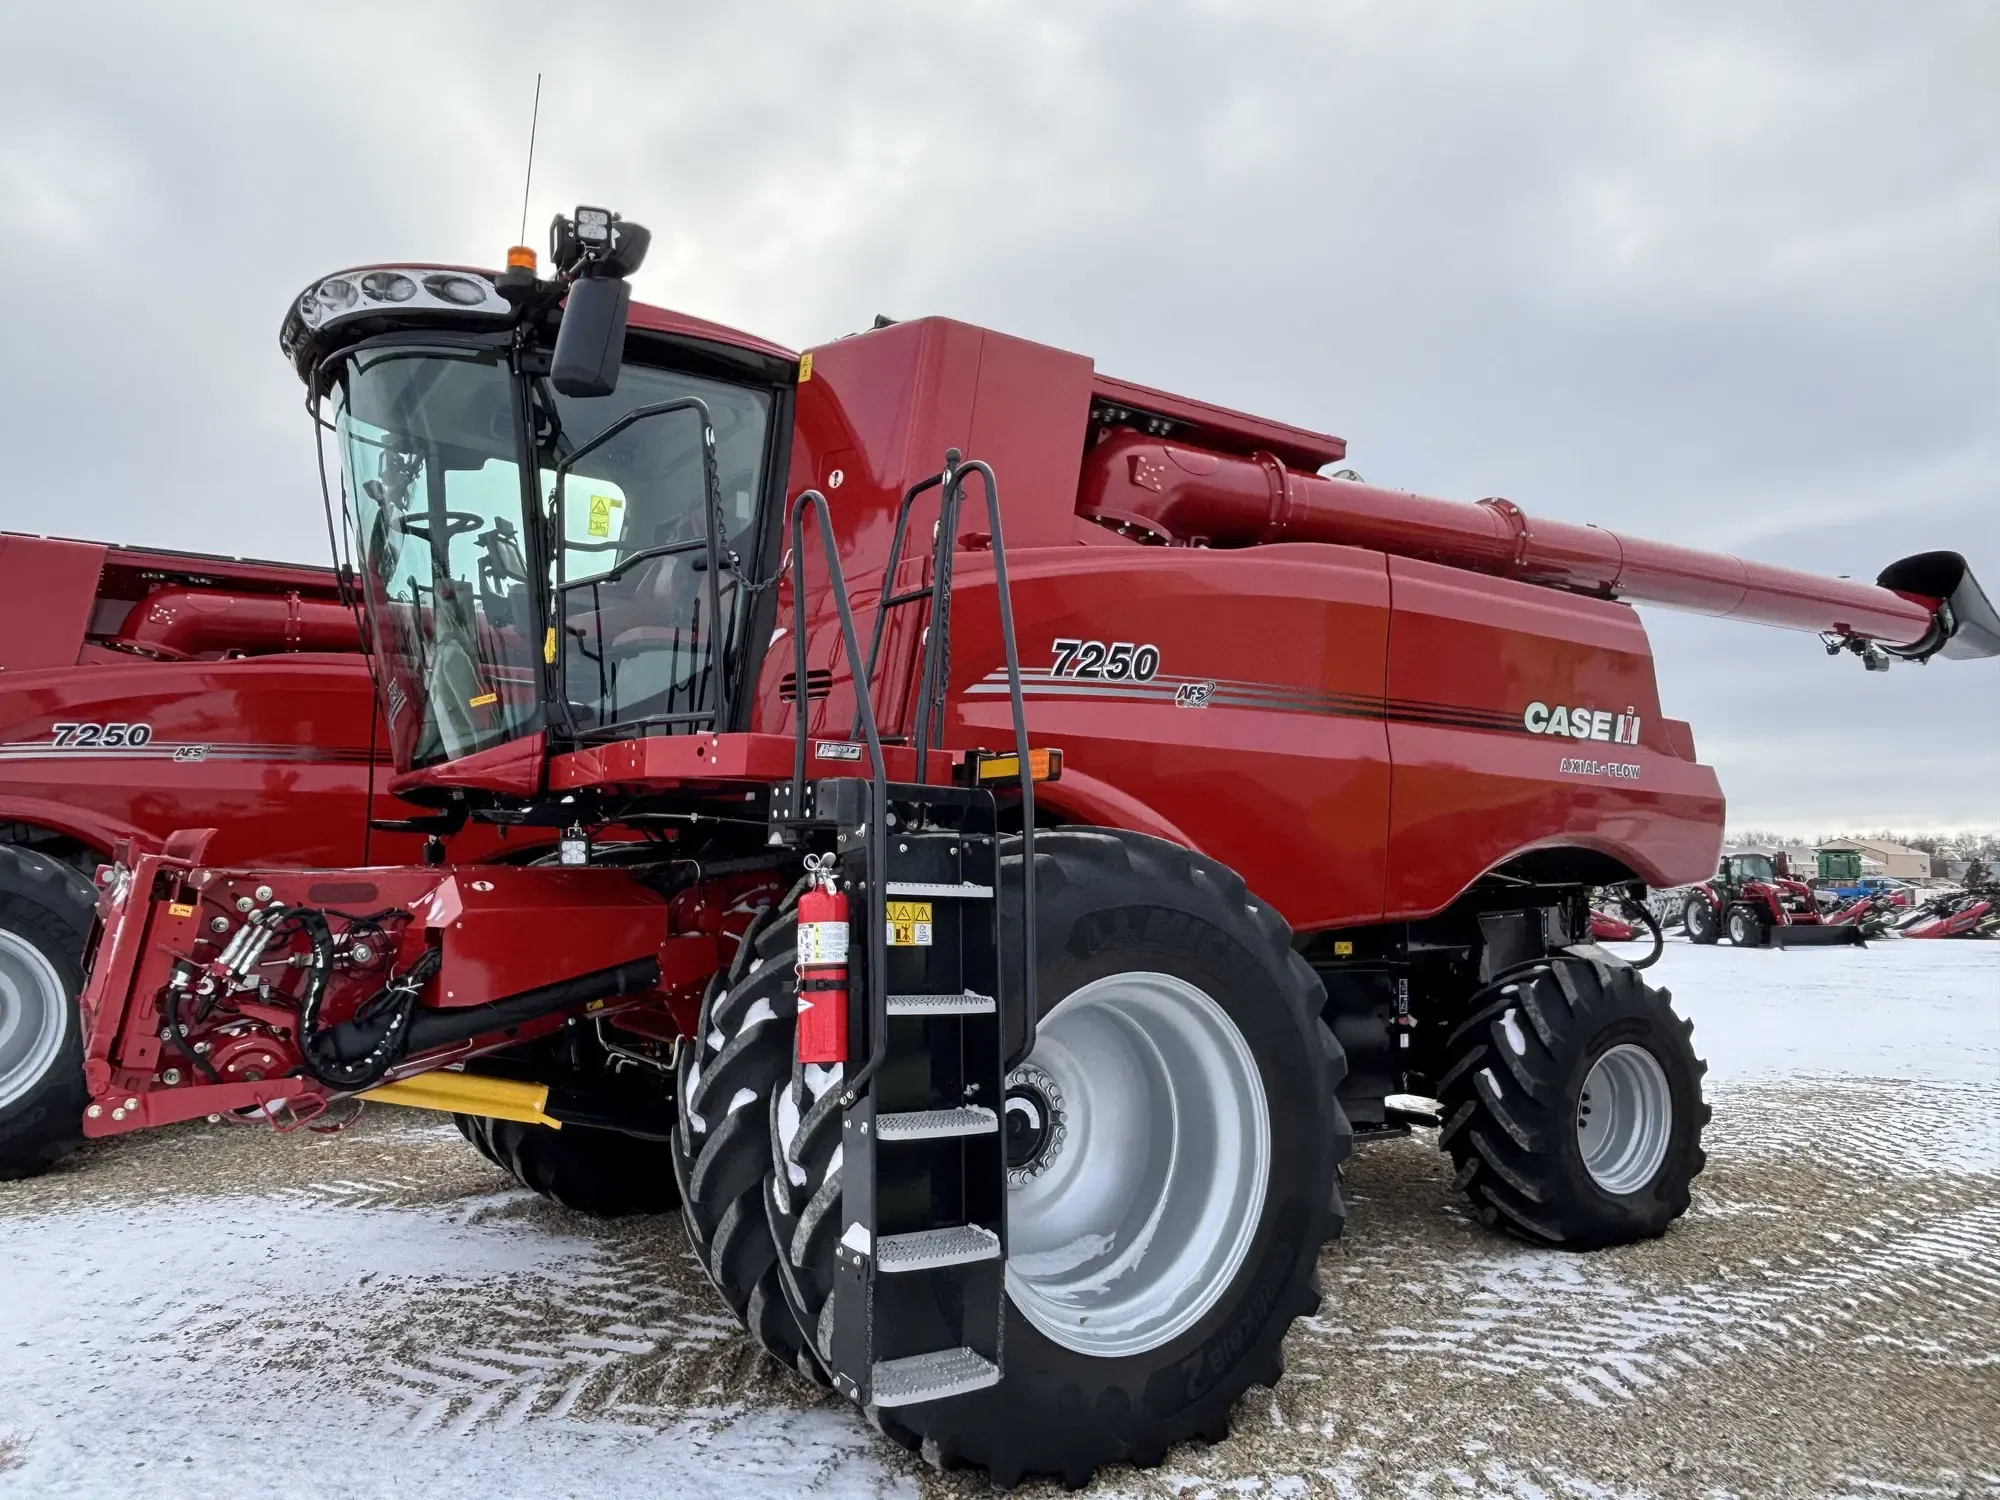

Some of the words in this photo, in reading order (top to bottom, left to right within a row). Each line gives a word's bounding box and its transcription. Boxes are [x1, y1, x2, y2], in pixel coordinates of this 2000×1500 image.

[1051, 638, 1160, 683] 7250
[1176, 684, 1207, 700] AFS
[1524, 701, 1612, 740] CASE
[52, 723, 152, 748] 7250
[174, 746, 203, 757] AFS
[1560, 758, 1640, 779] AXIAL-FLOW
